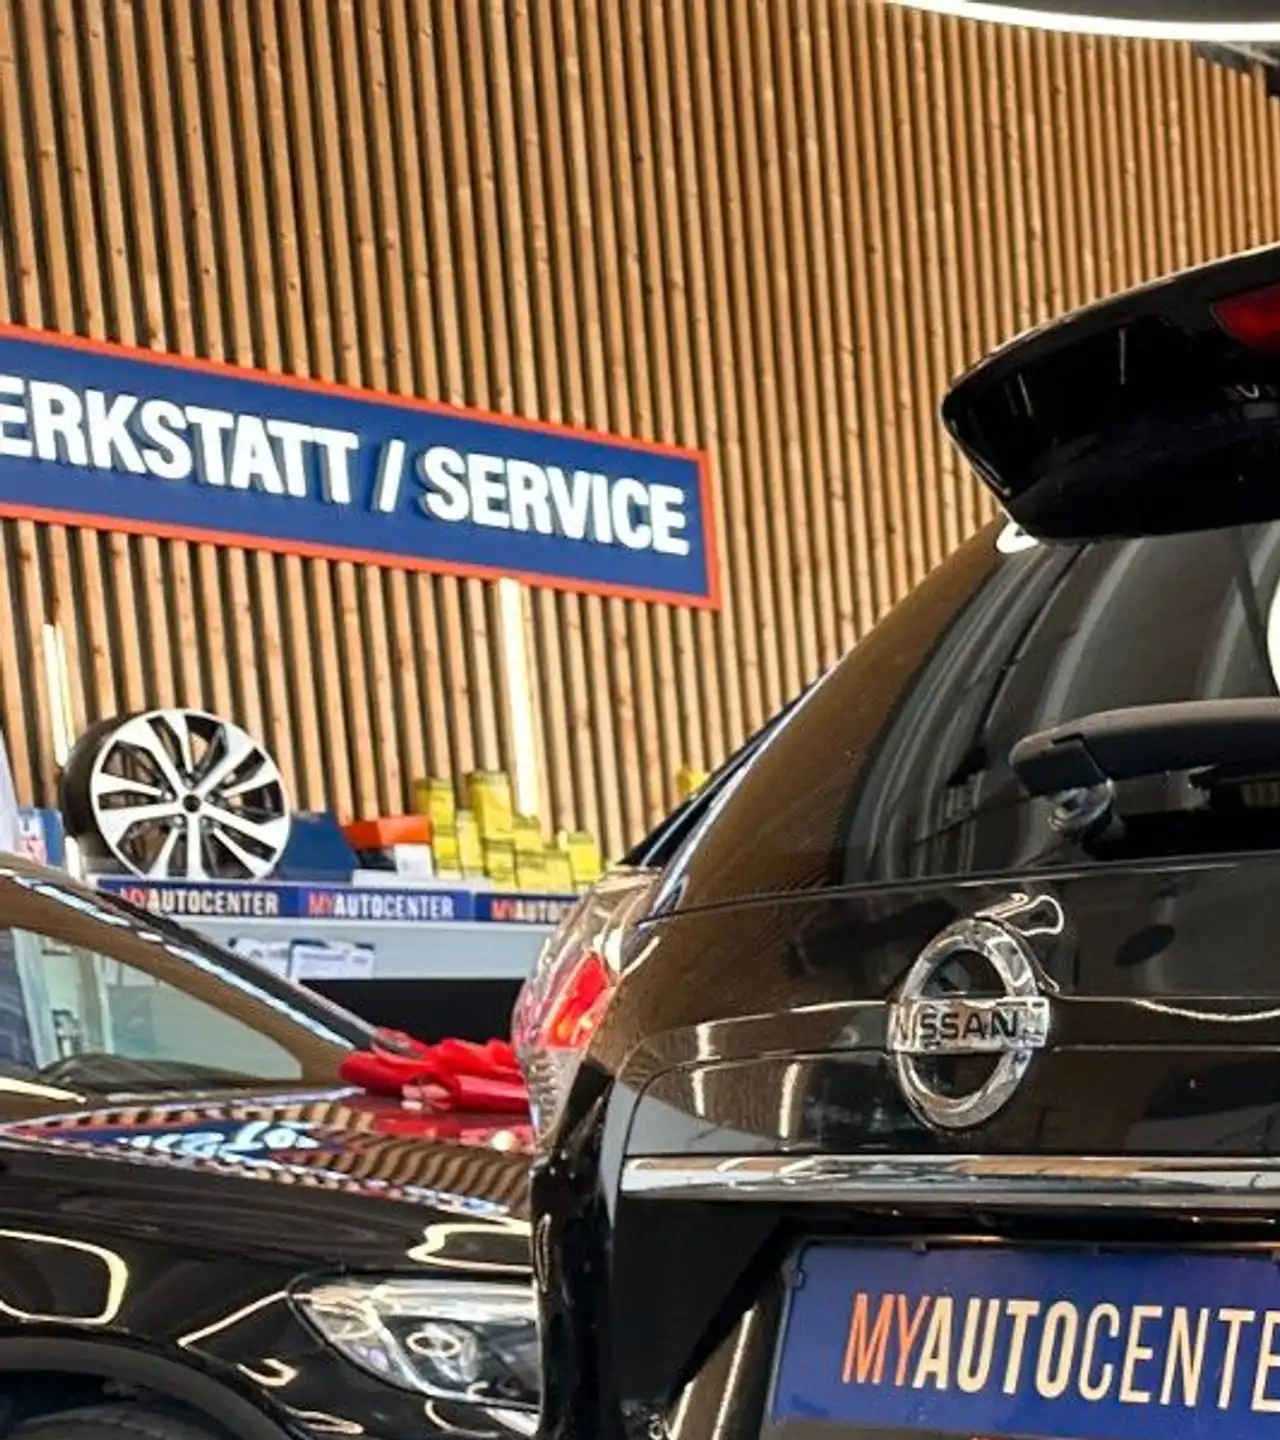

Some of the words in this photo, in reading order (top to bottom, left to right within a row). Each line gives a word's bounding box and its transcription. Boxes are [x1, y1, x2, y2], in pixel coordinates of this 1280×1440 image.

[420, 445, 691, 557] SERVICE
[308, 892, 455, 920] MYAUTOCENTER
[892, 1003, 1019, 1045] NISSAN
